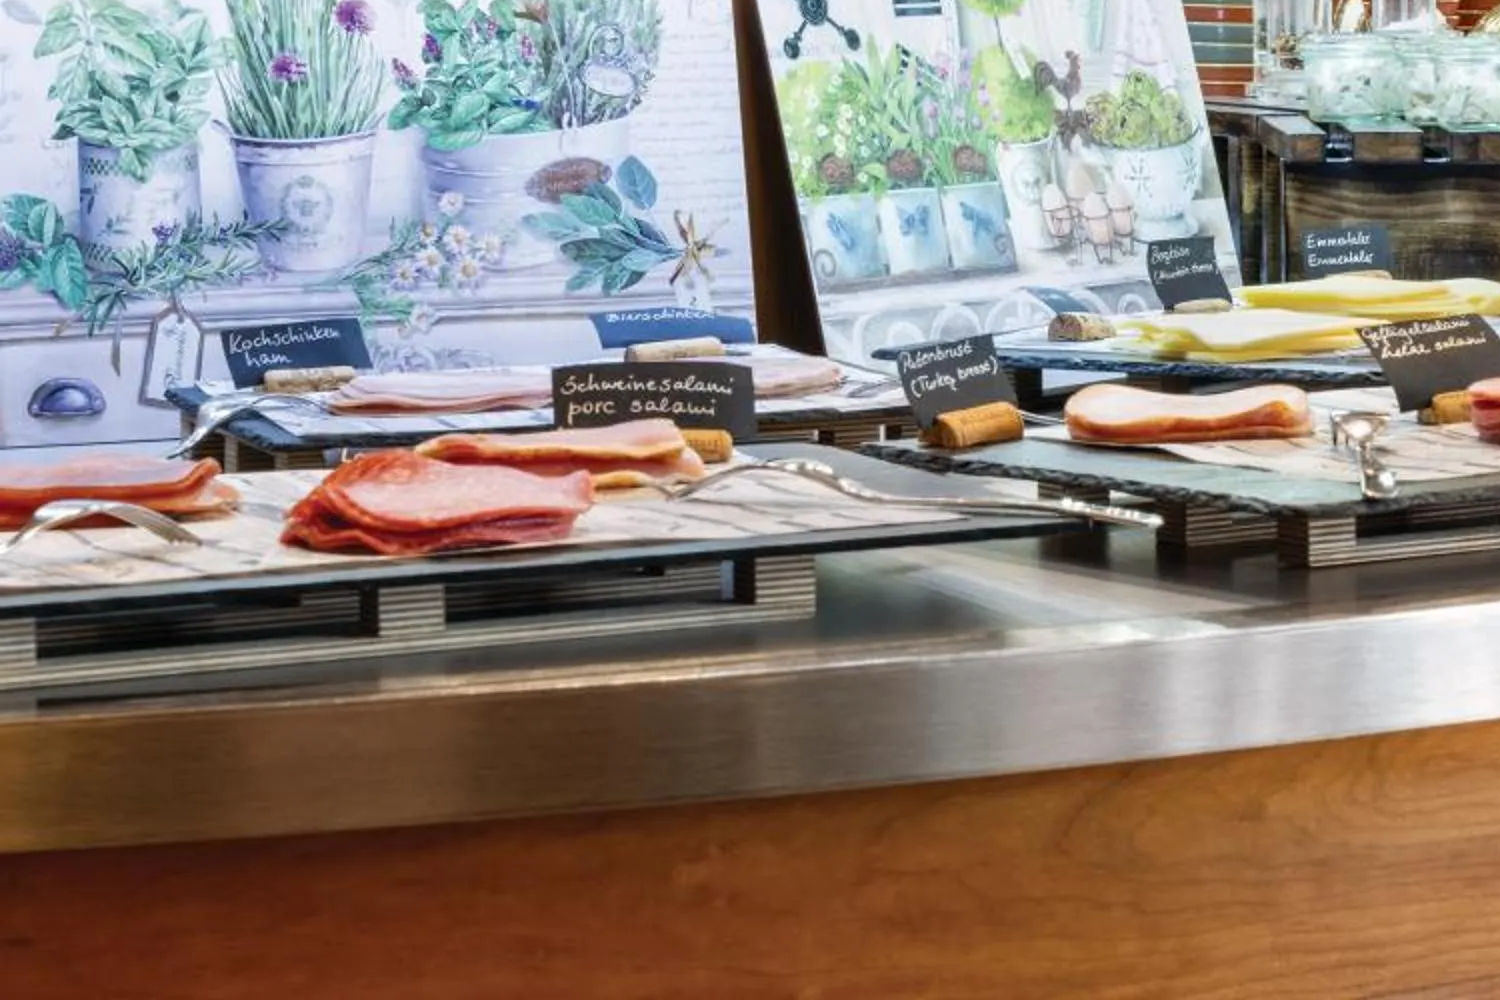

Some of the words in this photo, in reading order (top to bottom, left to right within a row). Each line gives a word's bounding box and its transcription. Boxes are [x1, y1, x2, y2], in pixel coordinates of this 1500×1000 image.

[244, 350, 292, 368] ham
[567, 399, 617, 427] porc
[629, 399, 717, 417] salami
